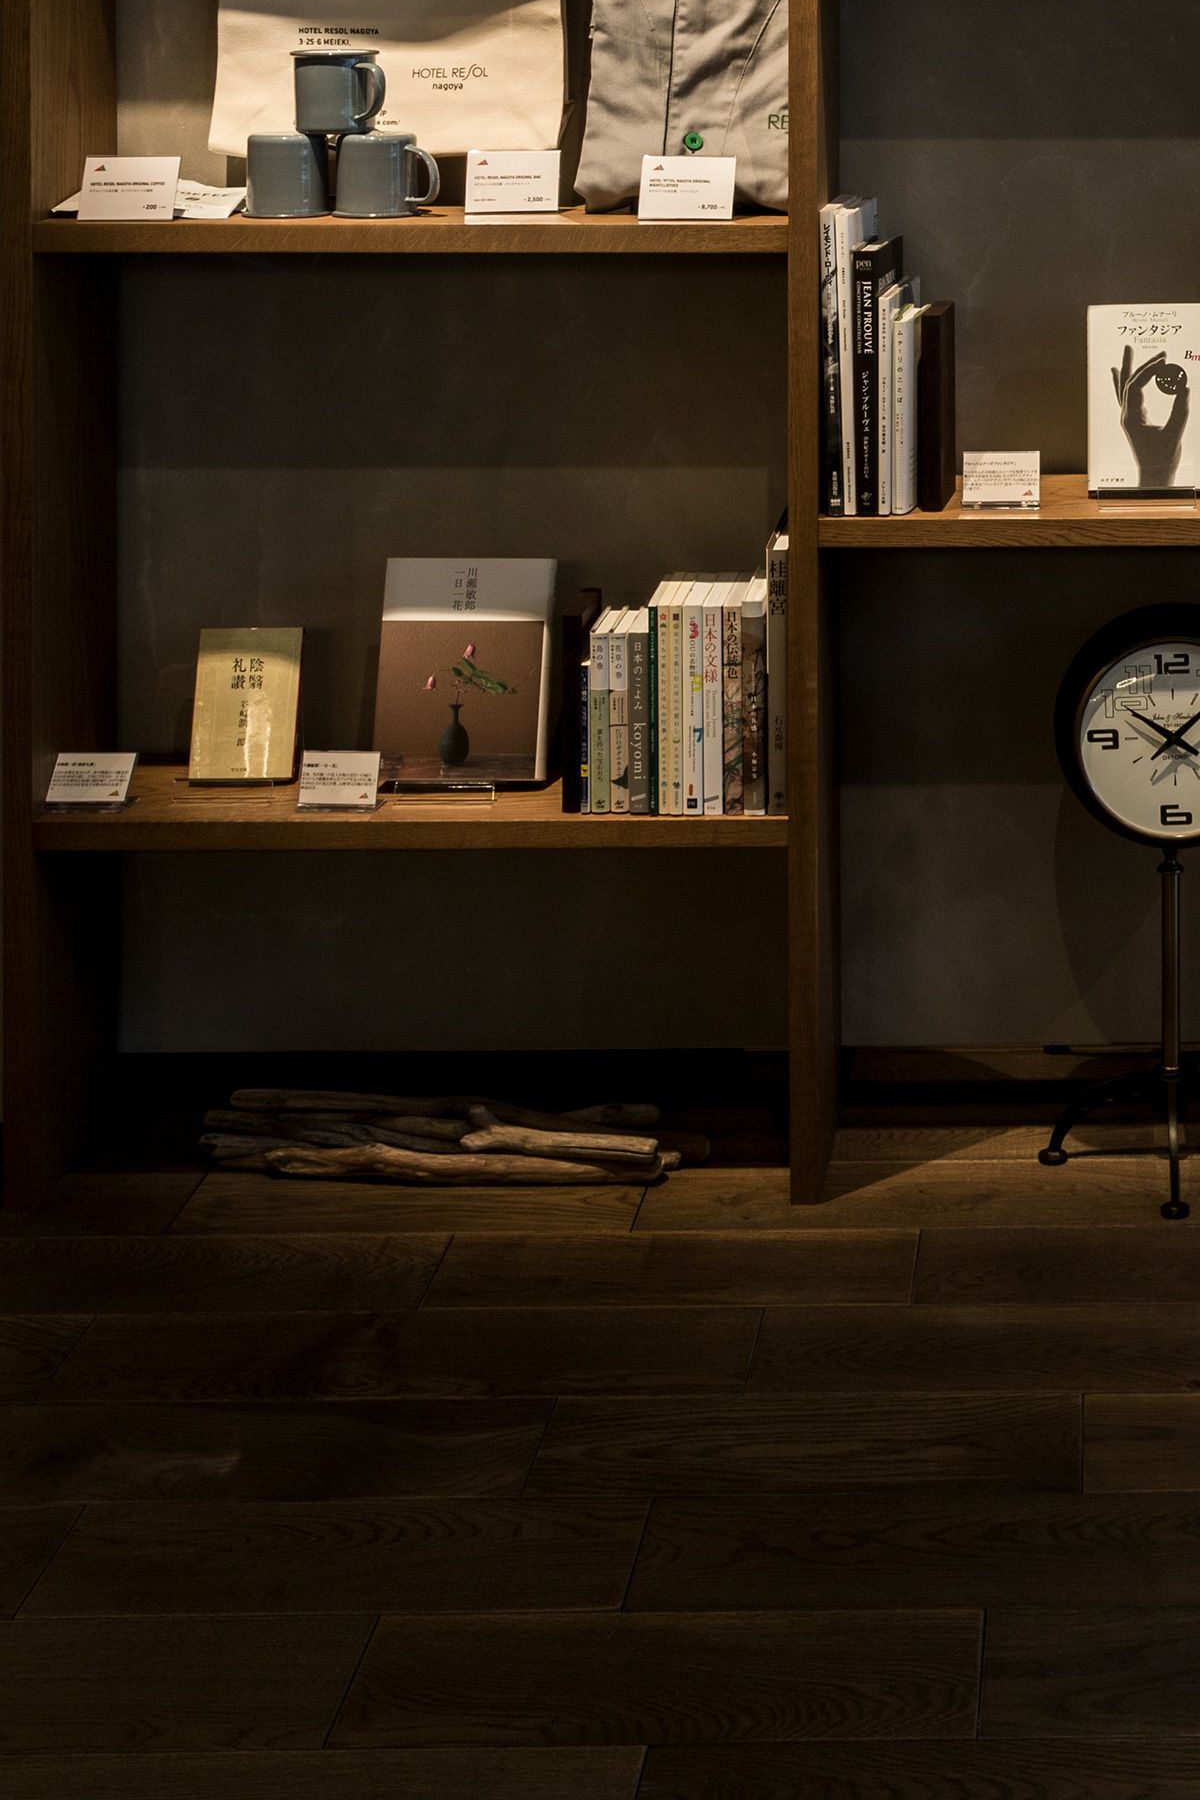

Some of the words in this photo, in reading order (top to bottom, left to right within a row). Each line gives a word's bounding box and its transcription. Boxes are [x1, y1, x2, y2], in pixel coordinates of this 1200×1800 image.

[298, 27, 323, 35] HOTEL
[350, 28, 379, 36] NAGOYA
[412, 67, 448, 79] HOTEL
[451, 63, 489, 81] RESOL
[432, 82, 464, 91] nagoya
[855, 260, 872, 271] pen
[862, 281, 872, 308] JEAN
[863, 311, 875, 355] PROUVÉ
[1117, 324, 1182, 336] ファンタジア
[1133, 336, 1167, 344] Fantasia
[862, 370, 870, 432] ジャン・プルーヴェ
[452, 570, 466, 611] 一日一花
[464, 567, 479, 611] 川瀬敏郎
[770, 560, 786, 616] 桂離宮
[704, 613, 718, 683] 日本の文様
[726, 611, 738, 679] 日本の伝統色
[633, 641, 643, 710] 日本のこよみ
[1154, 653, 1190, 675] 12
[1124, 664, 1152, 695] 11
[1101, 689, 1149, 719] 10
[631, 722, 646, 780] koyomi
[1087, 728, 1120, 750] 9
[1160, 804, 1193, 826] 6
